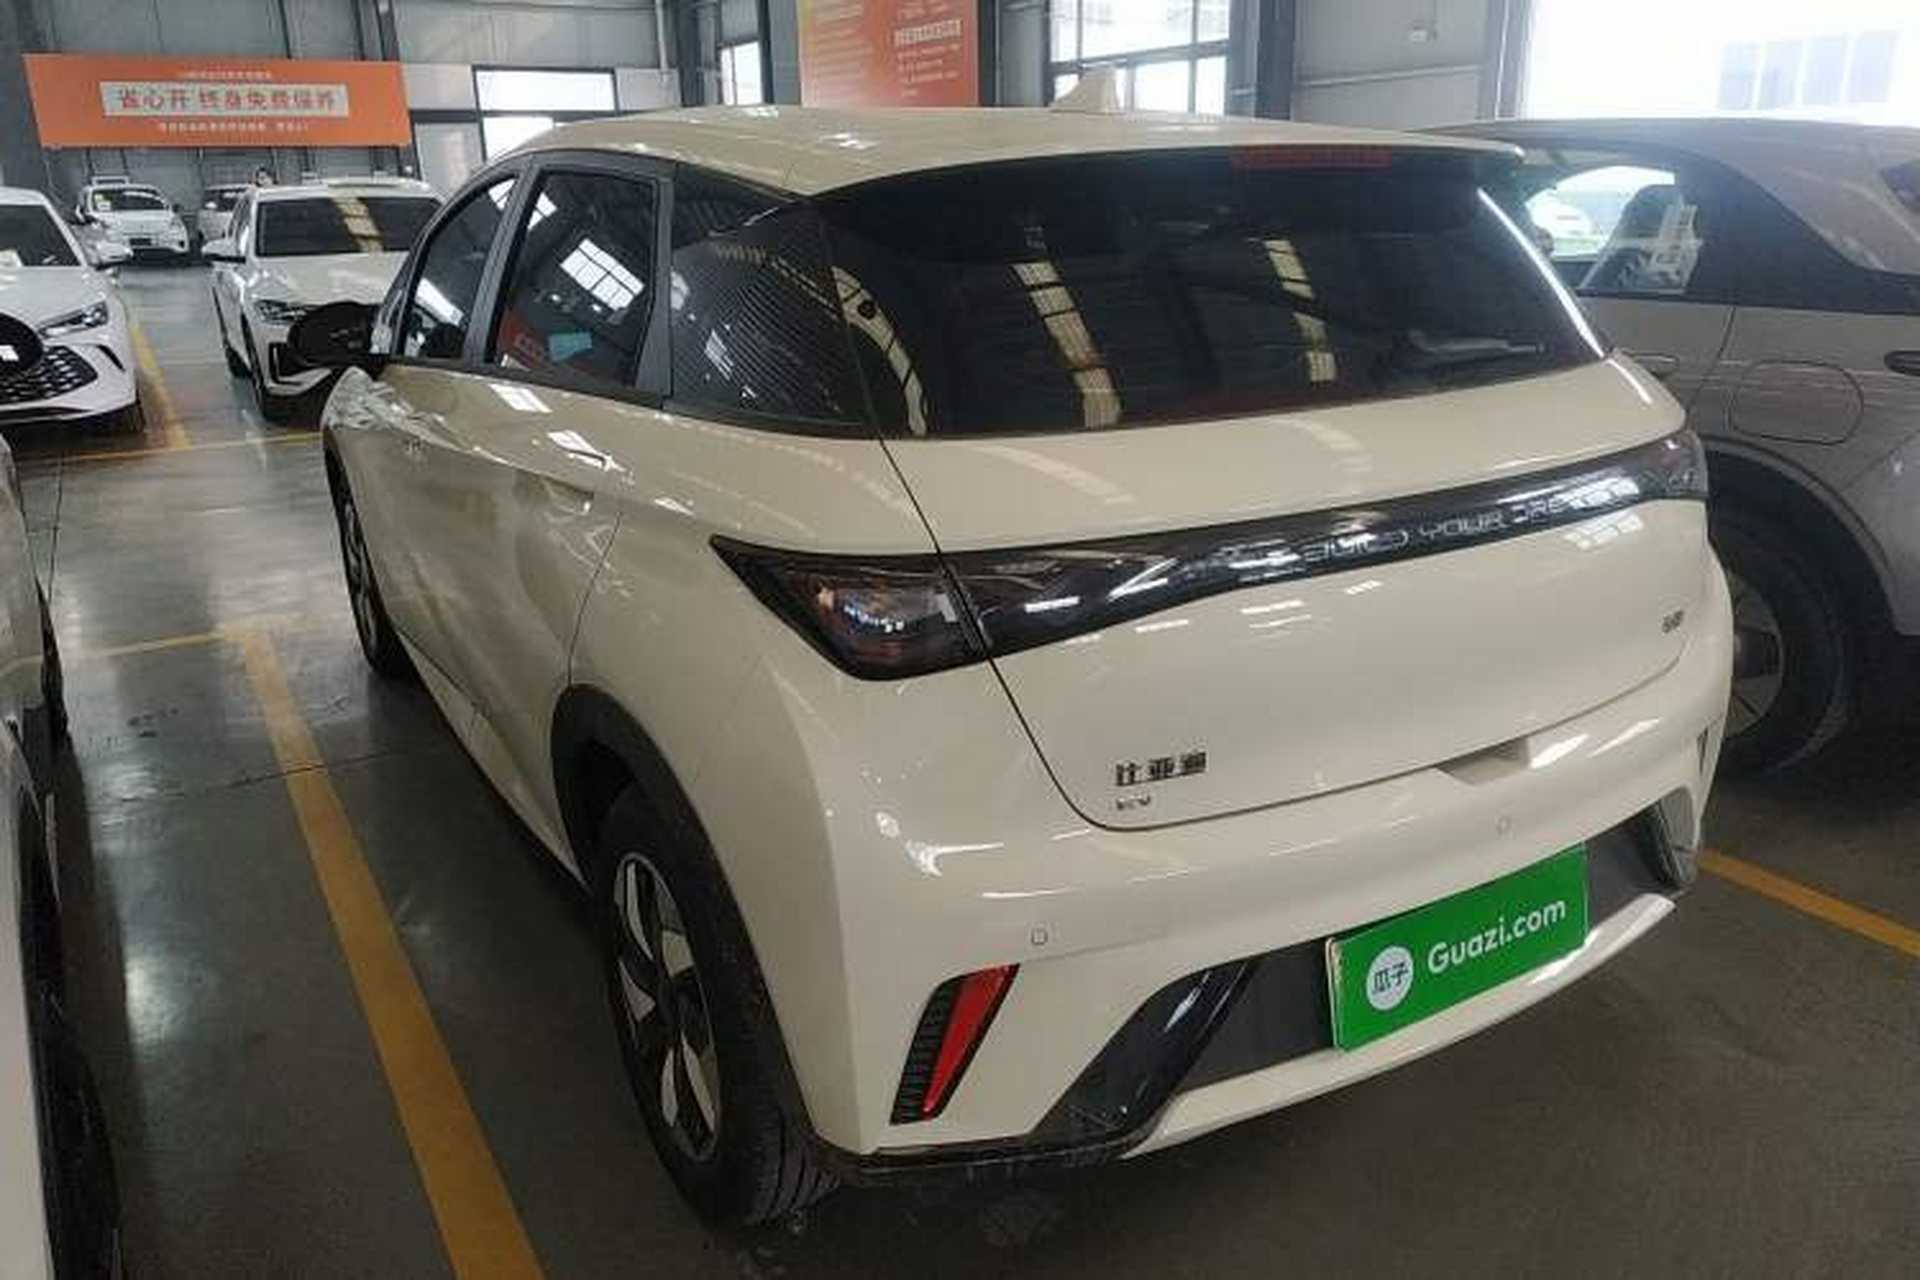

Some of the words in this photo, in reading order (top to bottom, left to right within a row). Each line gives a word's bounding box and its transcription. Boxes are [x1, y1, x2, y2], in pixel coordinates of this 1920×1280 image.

[1419, 512, 1508, 542] YOUR
[1427, 900, 1566, 974] Guazi.com
[1373, 962, 1409, 995] 瓜子
